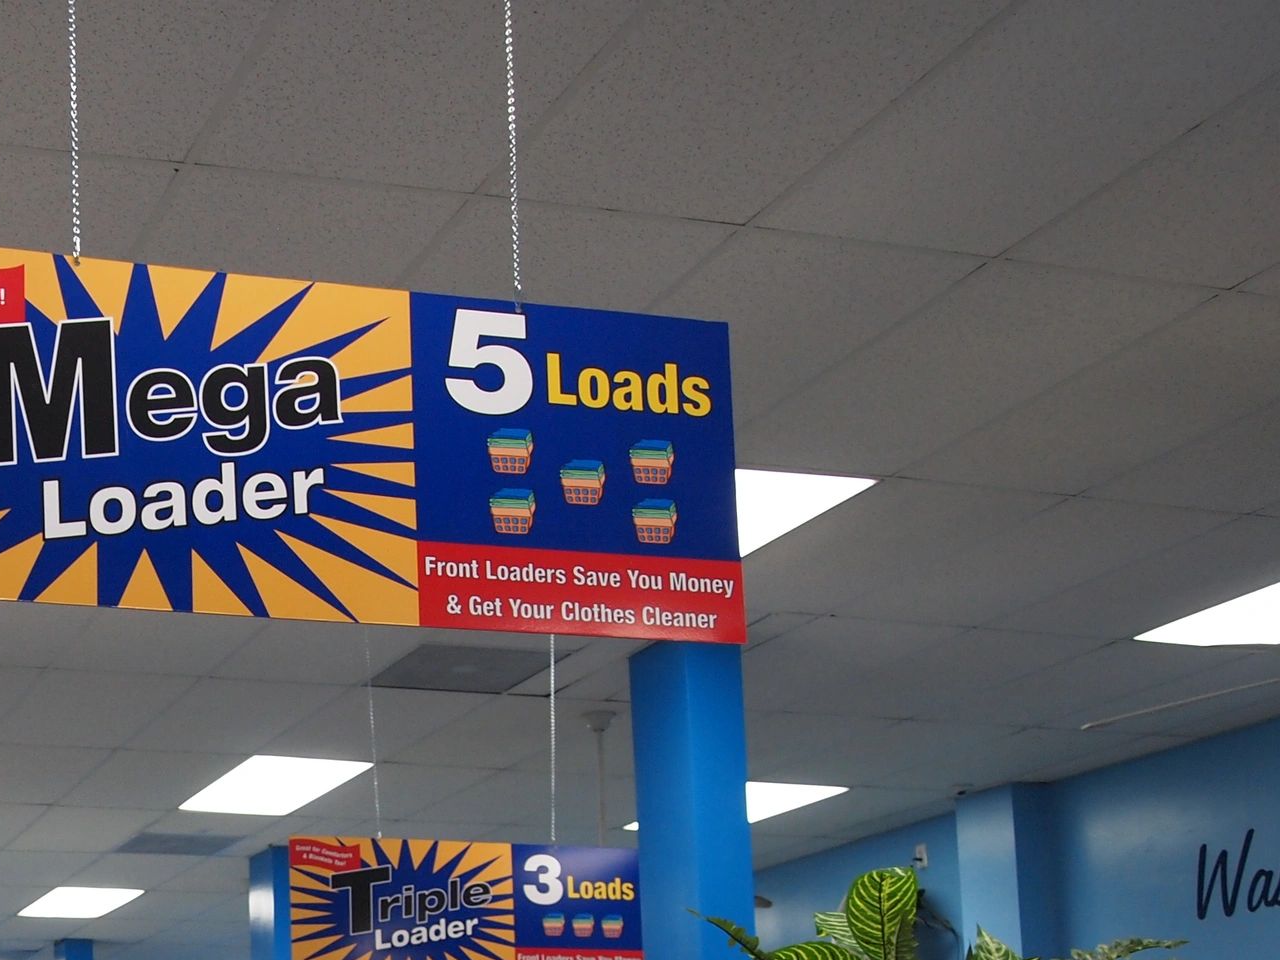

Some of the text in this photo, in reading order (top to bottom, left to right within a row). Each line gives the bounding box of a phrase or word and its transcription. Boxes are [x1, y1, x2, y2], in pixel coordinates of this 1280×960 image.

[444, 308, 712, 418] 5 Loads
[42, 462, 326, 541] Loader
[424, 556, 735, 599] Front Loaders Save You Money
[446, 595, 718, 629] & Get Your Clothes Cleaner
[330, 864, 493, 936] Triple
[522, 853, 635, 906] 3 Loads
[1196, 828, 1280, 920] Wa
[375, 917, 479, 951] Loader
